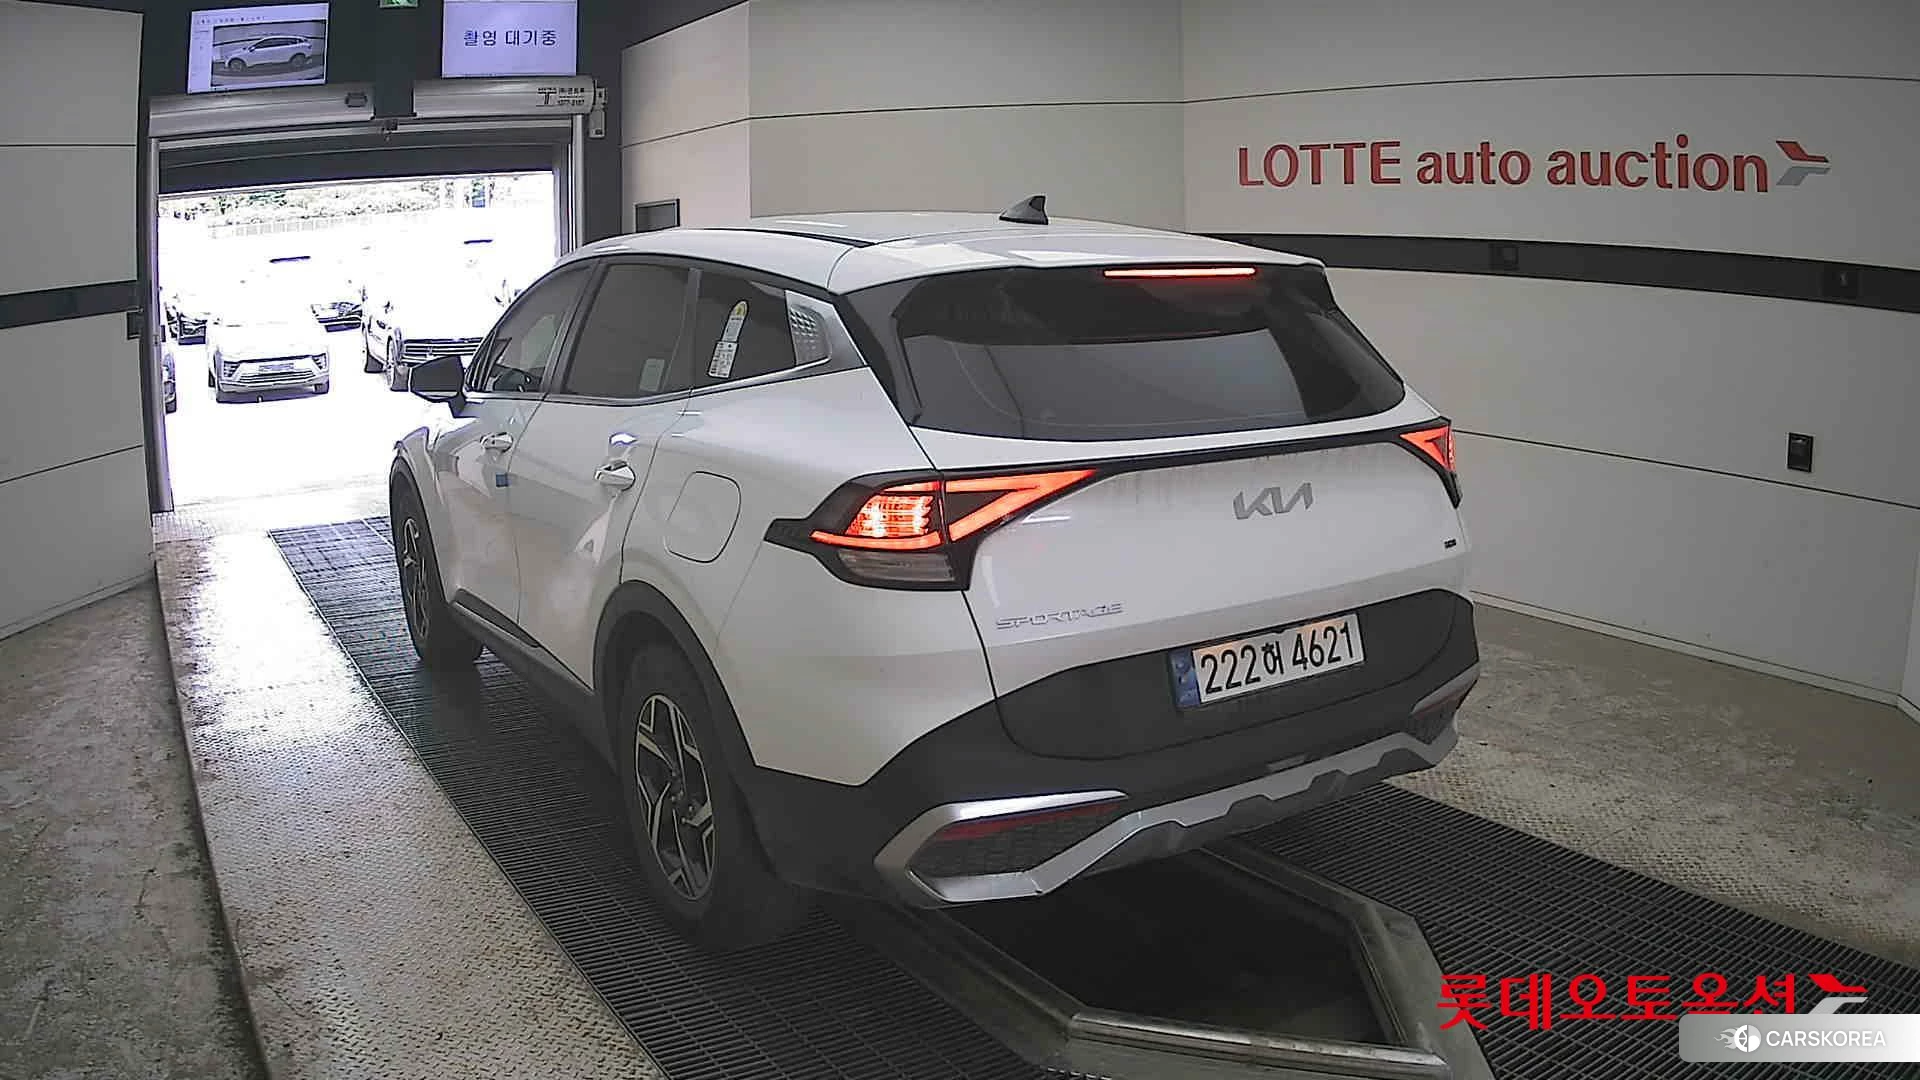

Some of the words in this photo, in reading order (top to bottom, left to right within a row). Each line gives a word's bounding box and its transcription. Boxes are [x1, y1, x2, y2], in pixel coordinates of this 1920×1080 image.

[463, 29, 497, 47] 촬영
[505, 29, 558, 47] 대기중
[1238, 141, 1401, 187] LOTTE
[1416, 141, 1531, 186] auto
[1546, 134, 1769, 193] auction
[1232, 482, 1314, 521] KIA
[995, 602, 1124, 630] SPORTAGE
[1292, 621, 1355, 671] 4621
